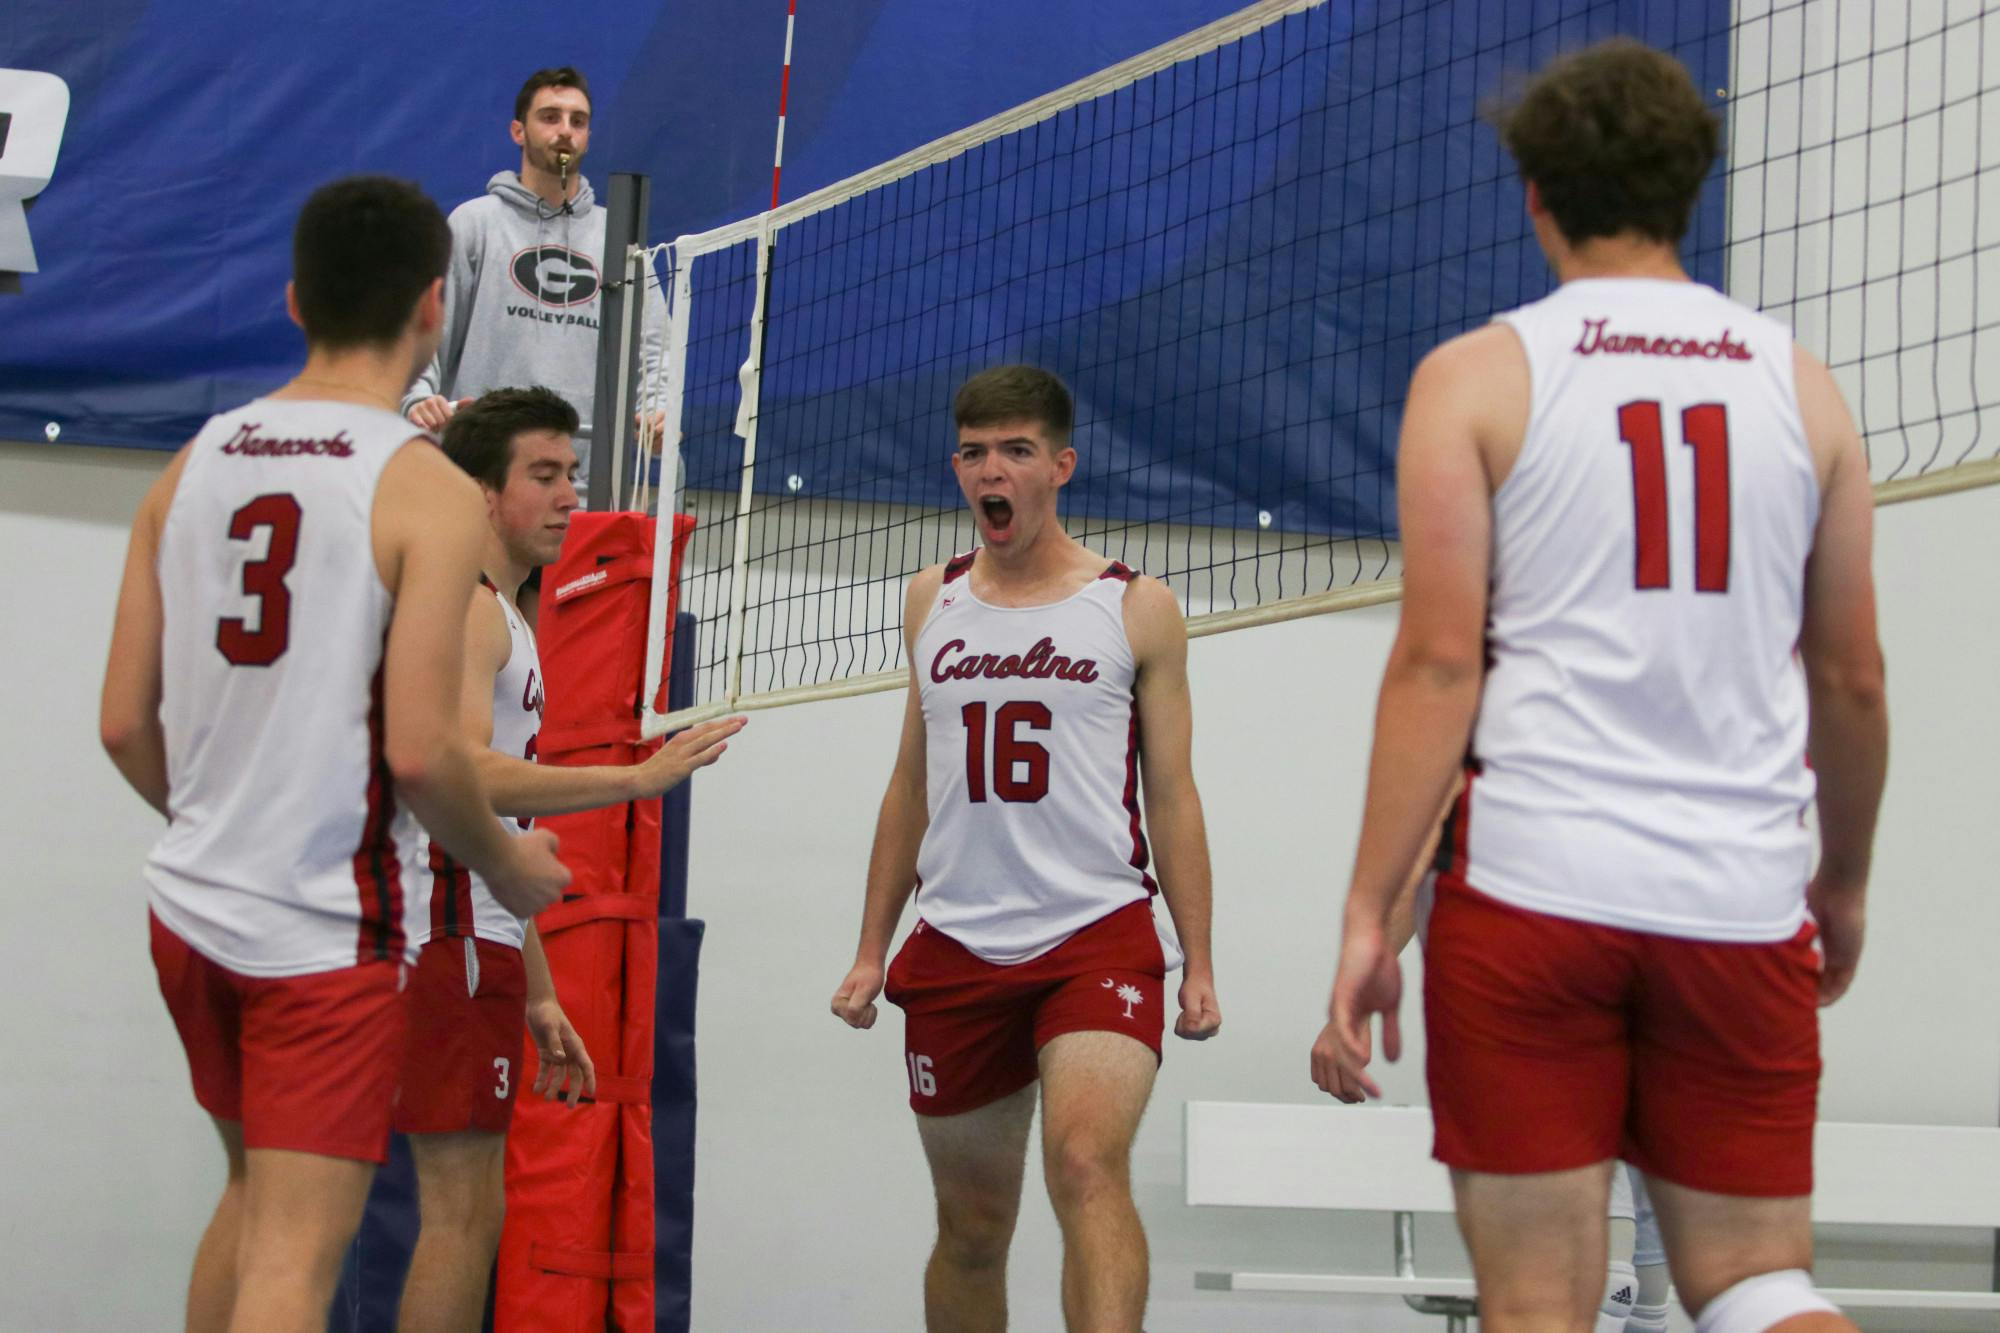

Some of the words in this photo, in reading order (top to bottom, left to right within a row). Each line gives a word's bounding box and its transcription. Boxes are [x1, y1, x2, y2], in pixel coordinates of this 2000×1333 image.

[506, 305, 600, 330] VOLLEYBALL
[1574, 317, 1754, 362] Gamecocks
[1617, 399, 1731, 593] 11
[215, 492, 303, 668] 3
[930, 636, 1100, 685] Carolina
[961, 700, 1053, 804] 16
[493, 1056, 510, 1099] 3
[908, 1051, 938, 1097] 16
